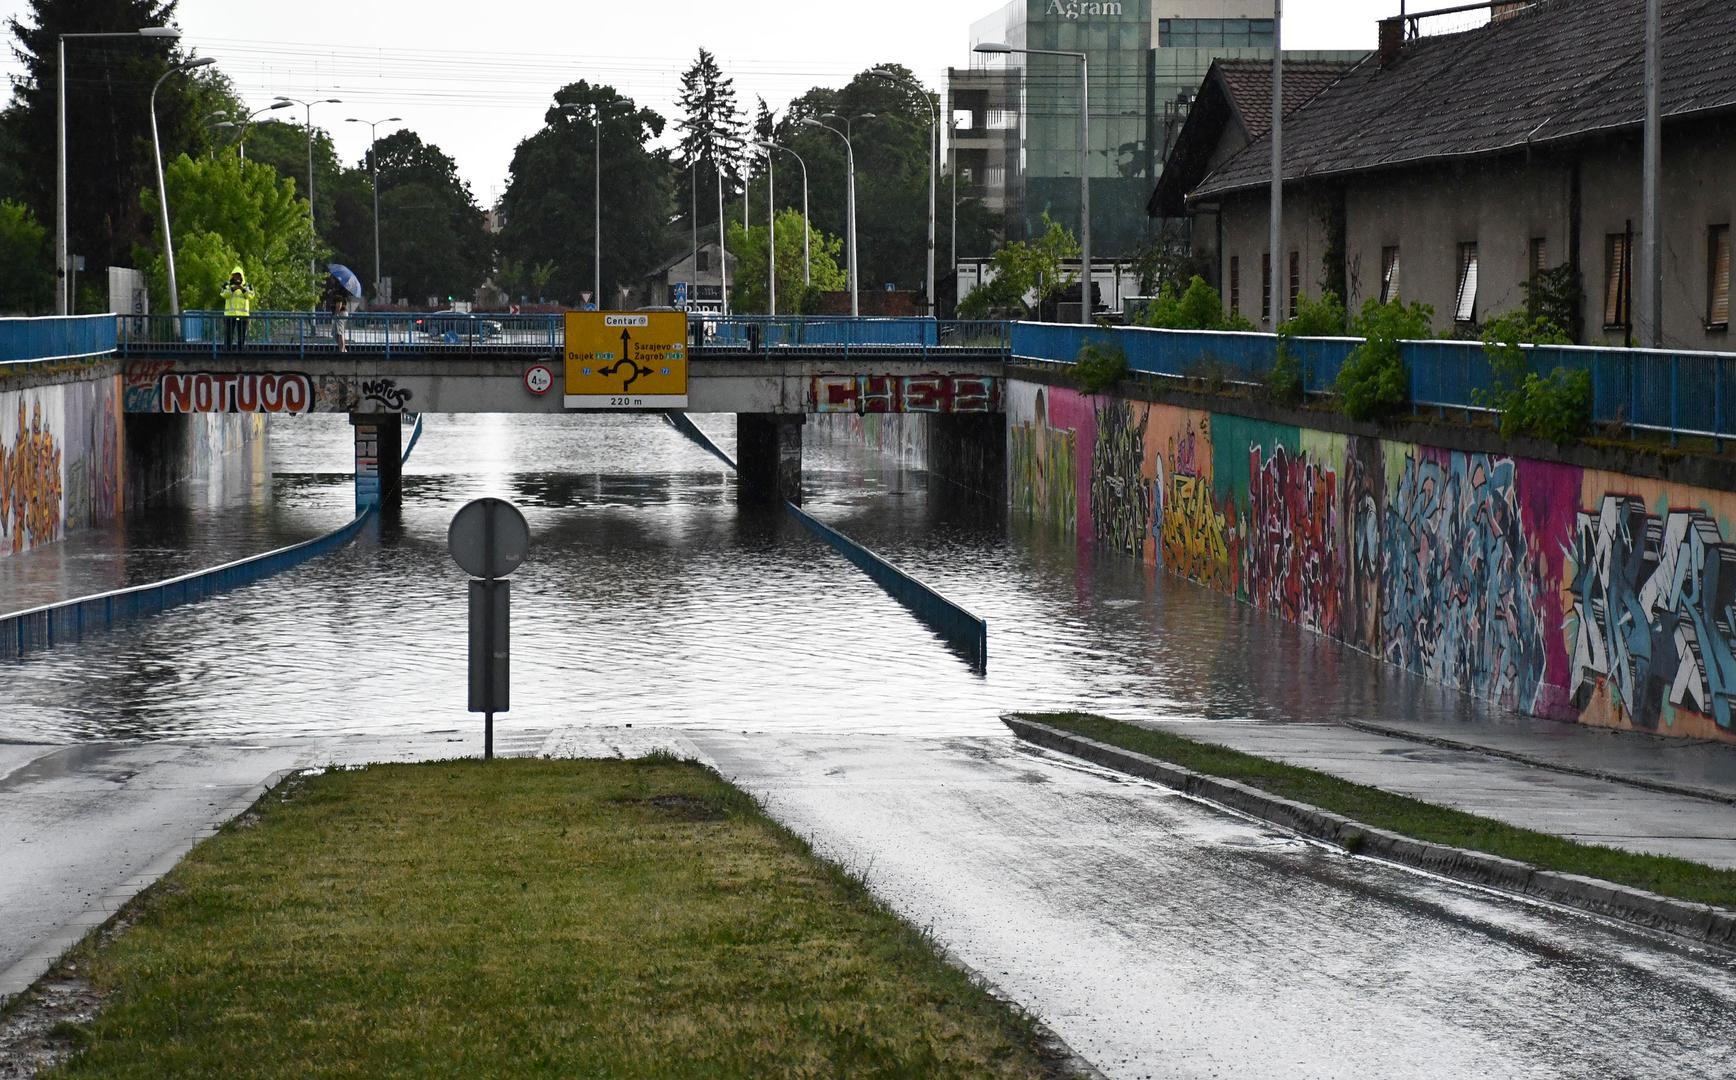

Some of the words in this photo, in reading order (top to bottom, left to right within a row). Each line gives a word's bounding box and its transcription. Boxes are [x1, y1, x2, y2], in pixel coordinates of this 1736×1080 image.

[1046, 0, 1122, 19] Agram
[606, 316, 637, 325] Centar
[634, 342, 671, 352] Sarajevo
[568, 352, 594, 361] Osijek
[634, 352, 664, 361] Zagreb
[611, 398, 630, 406] 220
